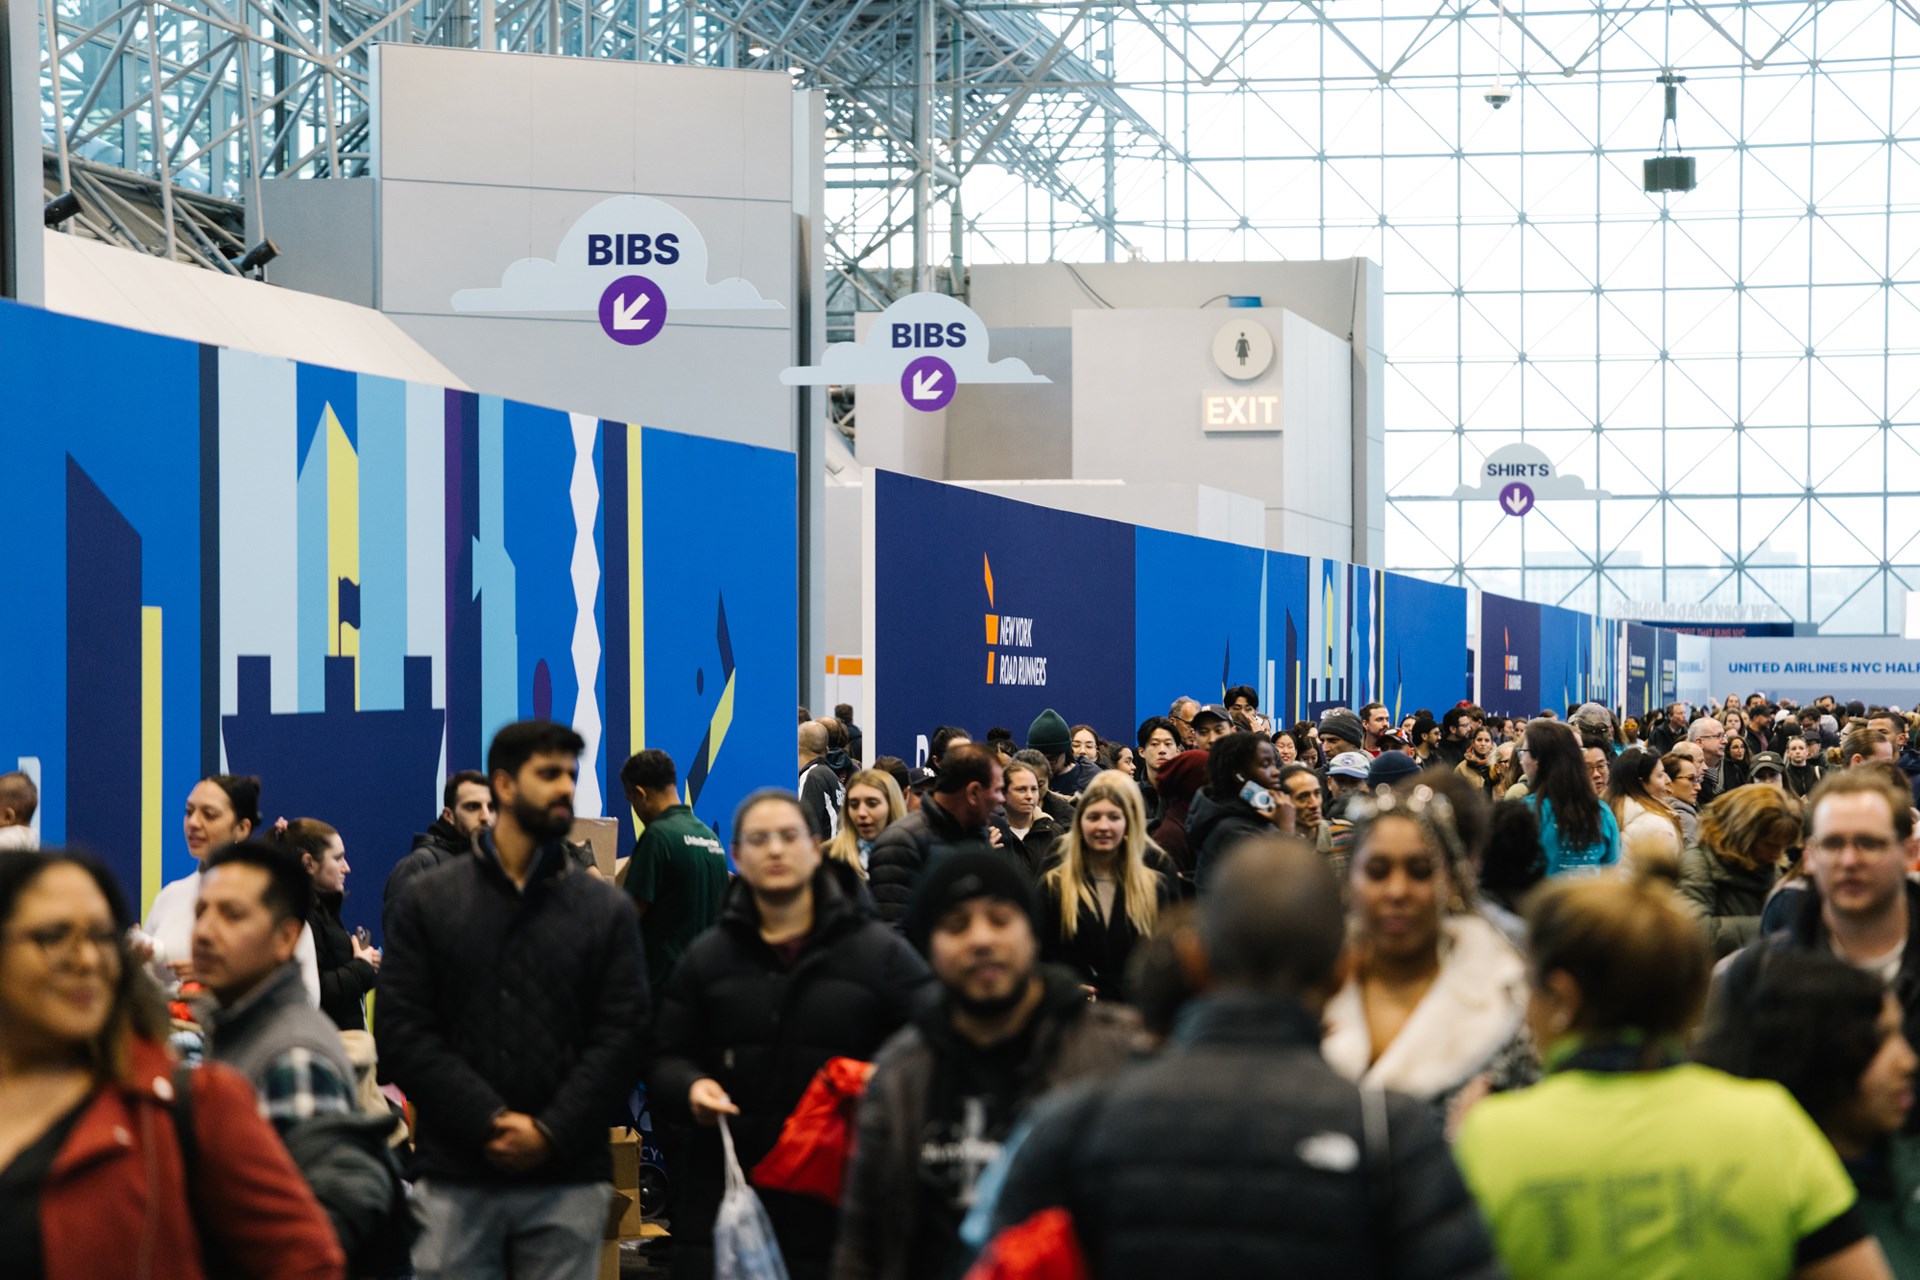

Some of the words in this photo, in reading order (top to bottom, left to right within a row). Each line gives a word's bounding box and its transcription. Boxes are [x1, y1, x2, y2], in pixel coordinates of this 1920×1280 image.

[588, 232, 680, 266] BIBS
[891, 322, 967, 349] BIBS
[1206, 396, 1278, 425] EXIT
[1486, 463, 1550, 477] SHIRTS
[1000, 615, 1016, 646] NEW
[1015, 617, 1033, 648] YORK
[999, 655, 1018, 685] ROAD
[1018, 656, 1047, 686] RUNNERS
[1728, 662, 1780, 674] UNITED
[1784, 662, 1848, 674] AIRLINES
[1851, 662, 1882, 674] NYC
